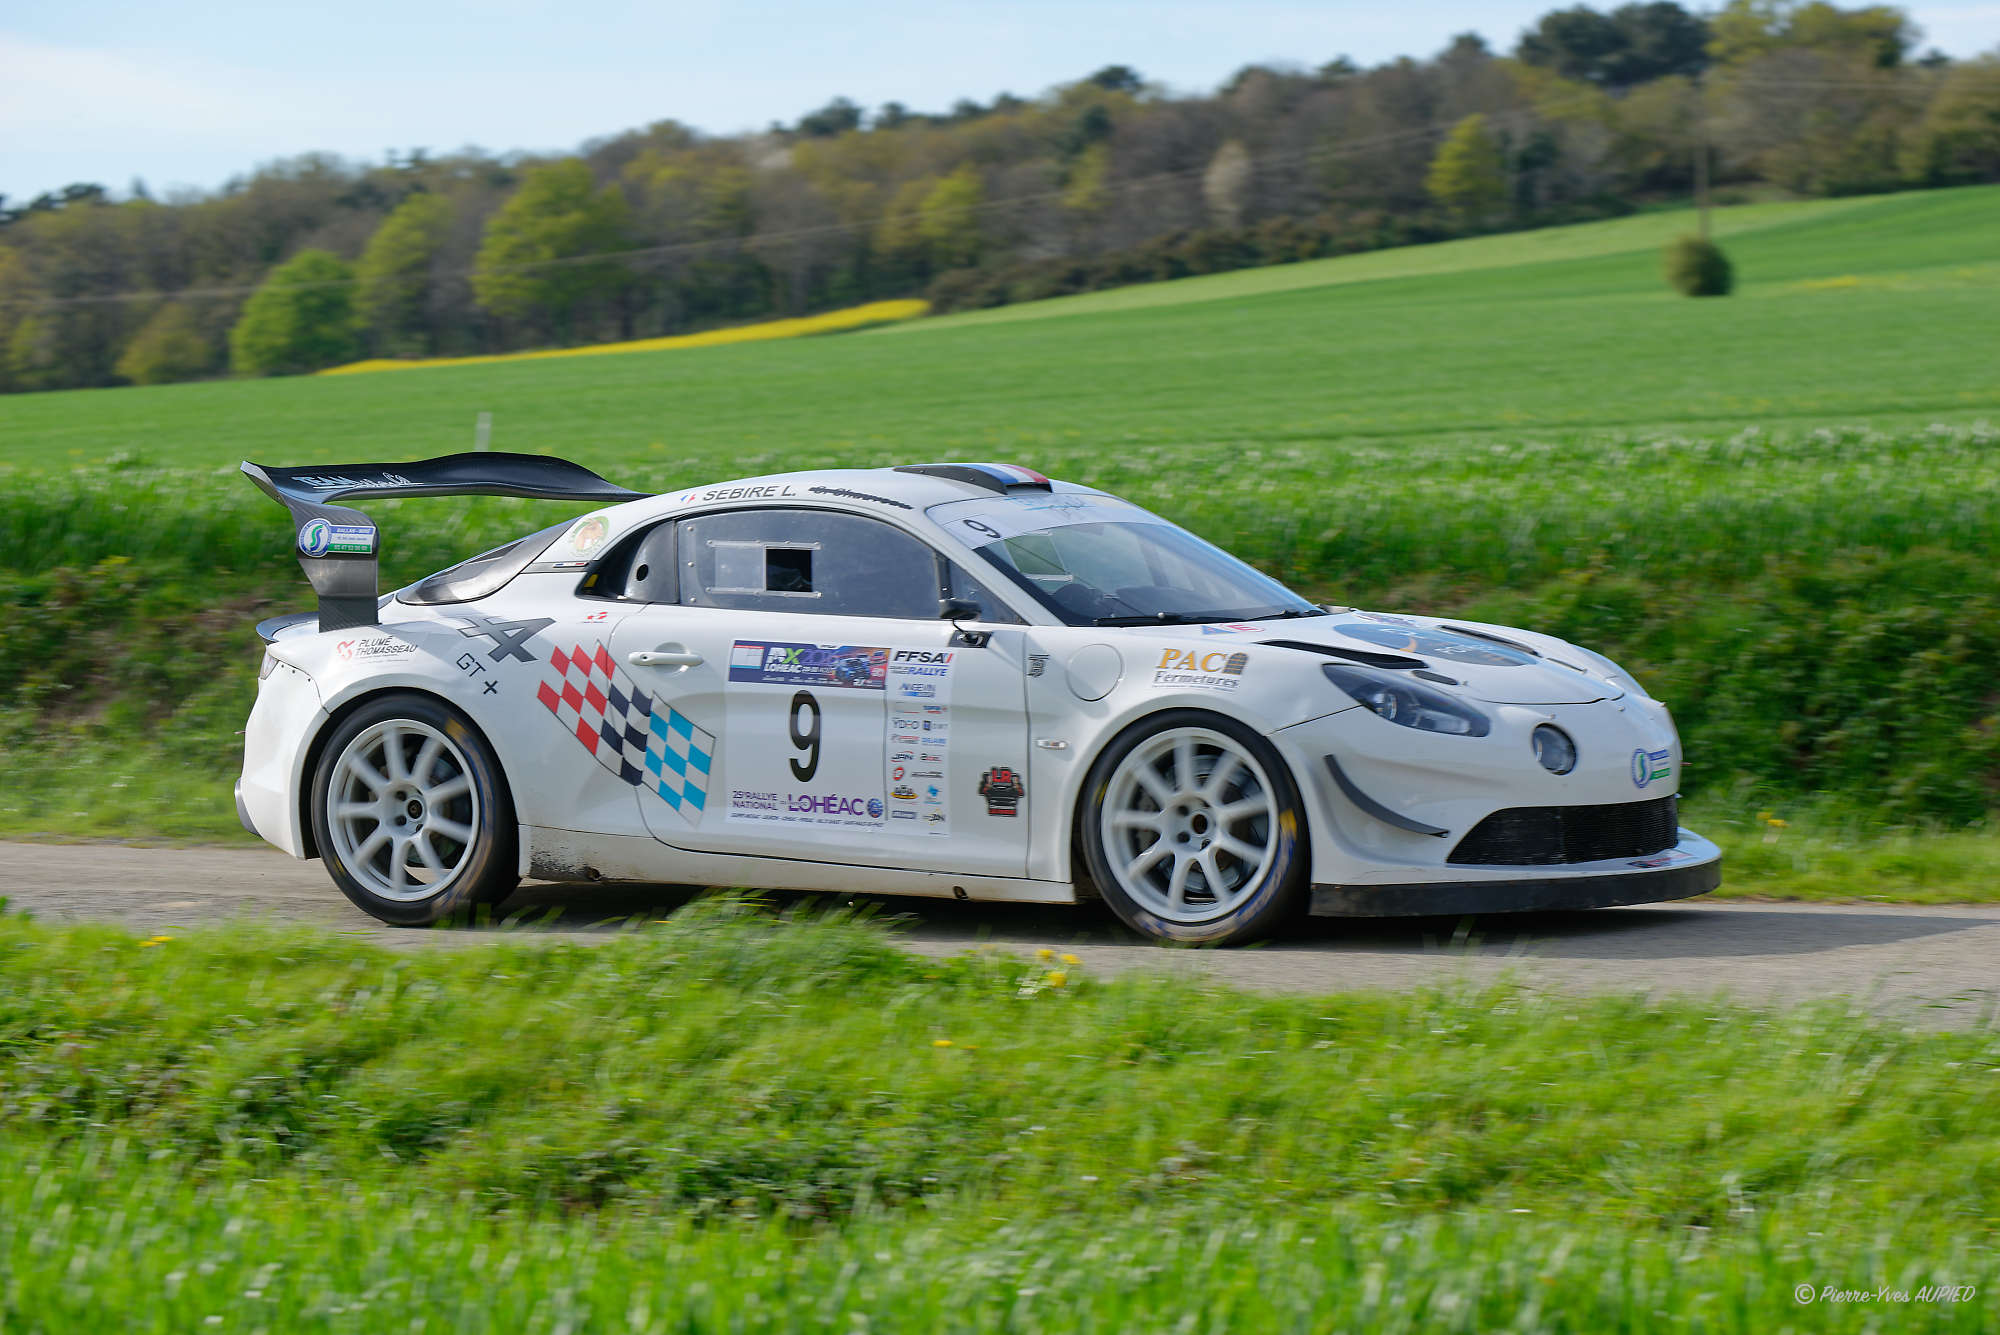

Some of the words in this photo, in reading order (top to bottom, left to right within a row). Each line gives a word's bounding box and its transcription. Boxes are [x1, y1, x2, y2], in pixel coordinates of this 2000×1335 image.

[703, 486, 779, 502] SEBIRE
[782, 484, 797, 497] L.
[963, 519, 1001, 538] 9
[355, 644, 418, 656] THOMASSEAU
[893, 650, 946, 664] FFSA
[456, 653, 486, 677] GT
[1155, 648, 1227, 673] PAC
[908, 666, 949, 677] RALLYE
[1154, 671, 1241, 687] Fermetures
[789, 689, 821, 783] 9
[732, 800, 779, 811] NATIONAL
[788, 793, 865, 816] LOHÉAC
